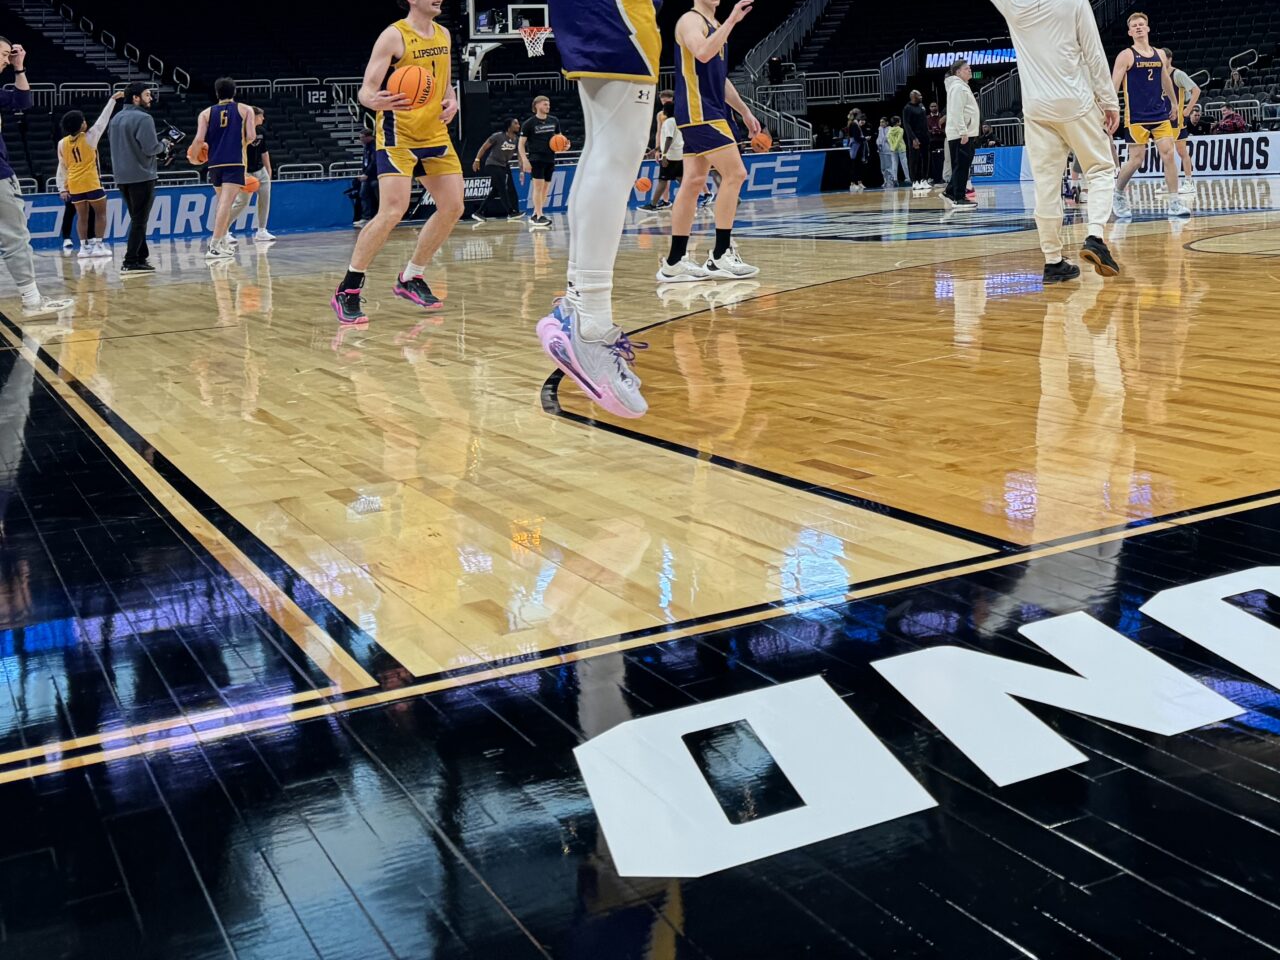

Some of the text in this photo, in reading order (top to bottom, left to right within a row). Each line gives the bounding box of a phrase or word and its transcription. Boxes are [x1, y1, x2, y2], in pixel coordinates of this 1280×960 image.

[925, 48, 1017, 69] MARCHMADNE
[431, 60, 436, 78] 1
[1147, 69, 1154, 81] 2
[307, 91, 327, 103] 122
[220, 109, 228, 128] 6
[72, 147, 82, 163] 11
